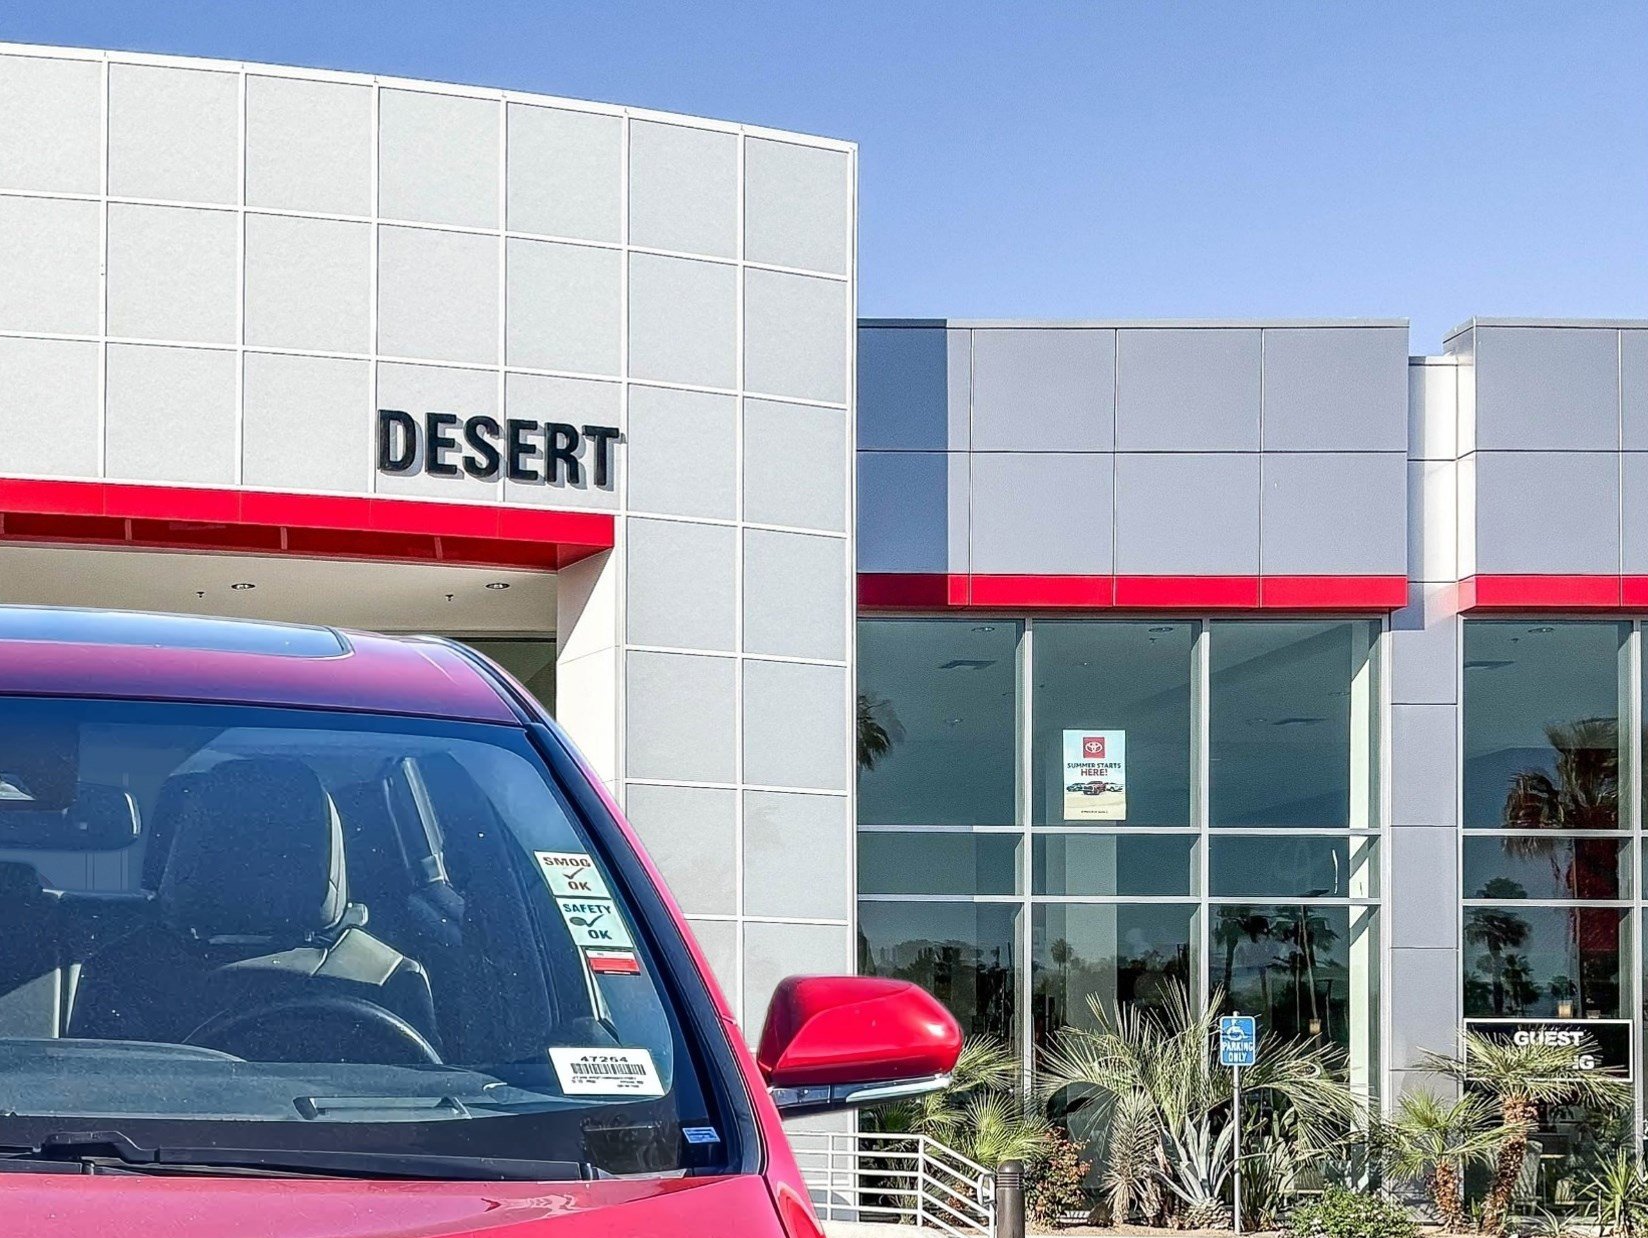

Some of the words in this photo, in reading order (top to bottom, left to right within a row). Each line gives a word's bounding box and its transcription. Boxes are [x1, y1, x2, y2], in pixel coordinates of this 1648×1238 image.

[377, 409, 620, 486] DESERT
[568, 881, 592, 892] OK
[563, 903, 613, 915] SAFETY
[588, 929, 612, 940] OK
[1513, 1031, 1584, 1047] GUEST
[1222, 1040, 1253, 1052] PARKING
[1228, 1051, 1248, 1063] ONLY
